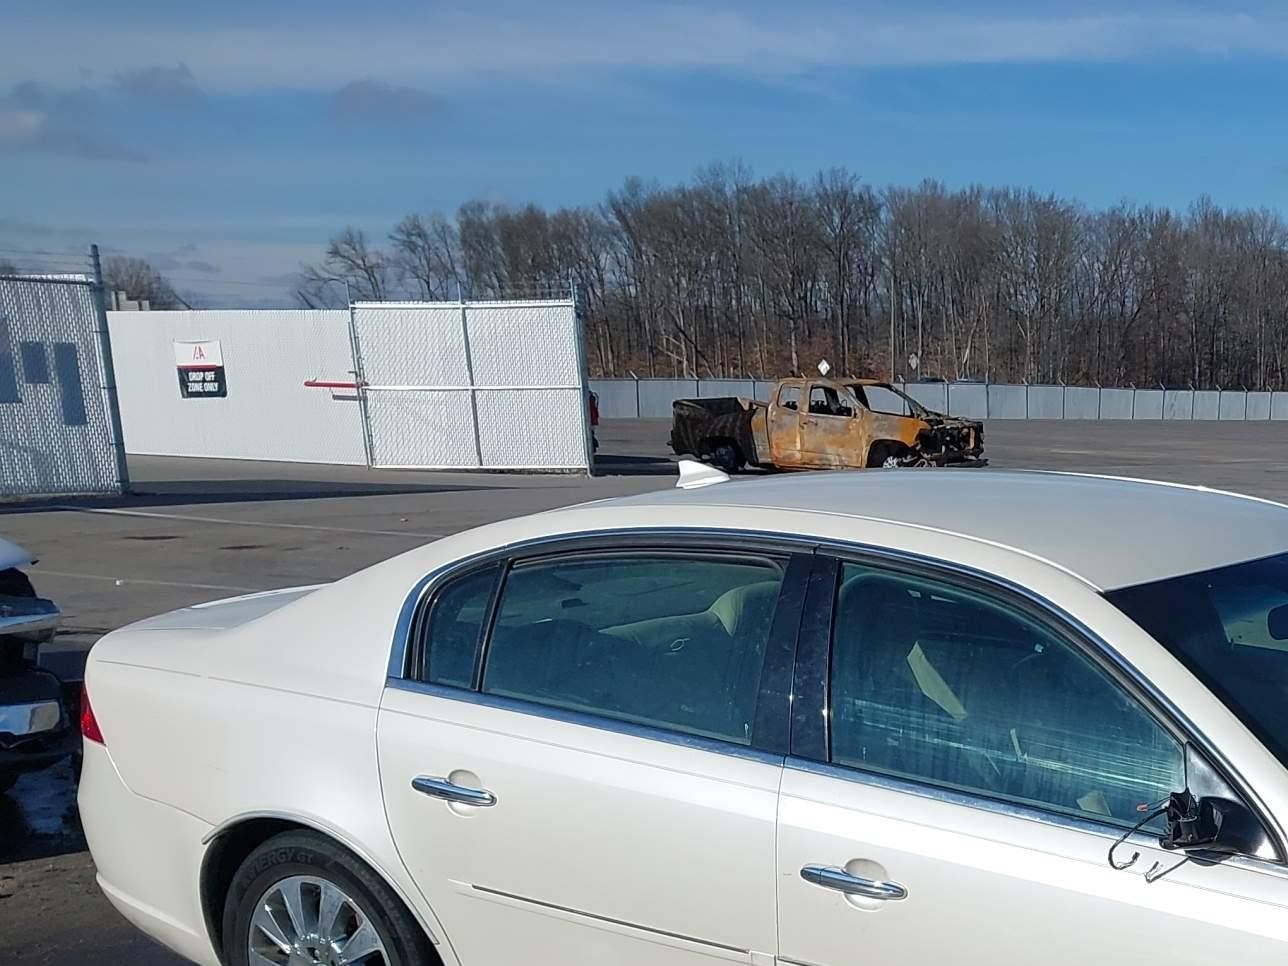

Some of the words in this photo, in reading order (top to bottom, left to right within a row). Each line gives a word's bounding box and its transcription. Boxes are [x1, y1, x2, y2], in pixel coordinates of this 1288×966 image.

[188, 371, 204, 381] DROP
[204, 371, 216, 381] OFF
[187, 382, 204, 392] ZONE
[203, 382, 219, 392] ONLY
